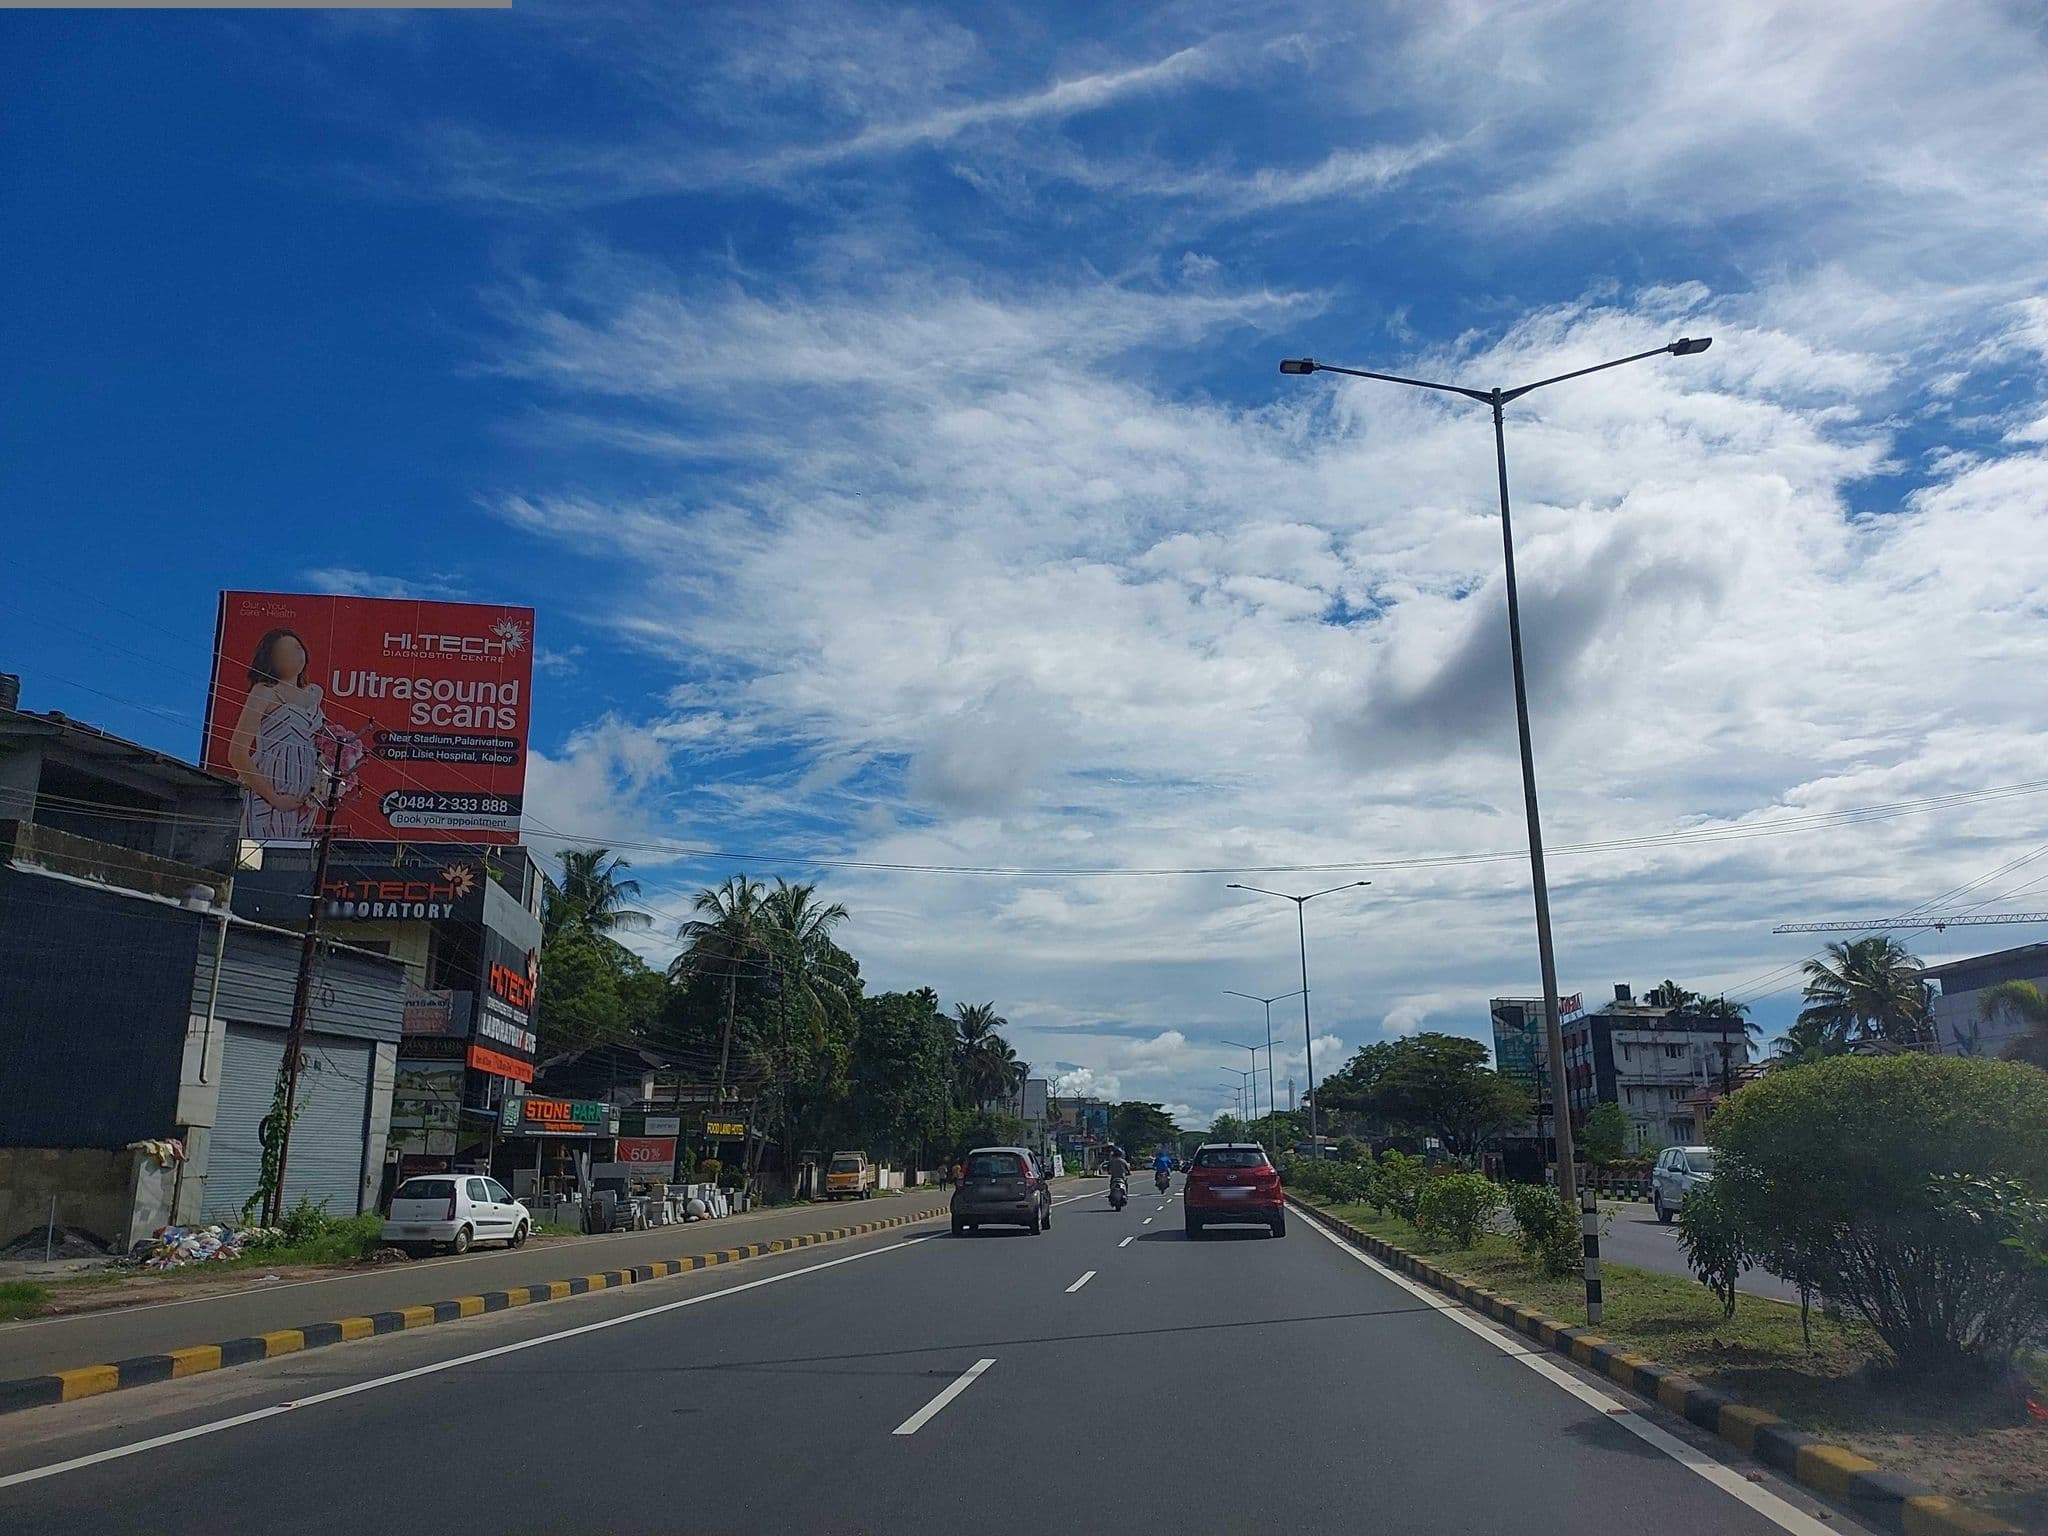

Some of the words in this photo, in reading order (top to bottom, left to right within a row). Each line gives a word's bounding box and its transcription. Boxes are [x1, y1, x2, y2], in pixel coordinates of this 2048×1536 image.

[383, 650, 453, 660] DIAGNOSTIC
[461, 654, 504, 663] CENTRE
[332, 670, 519, 705] Ultrasound
[410, 702, 517, 730] scans
[389, 733, 412, 743] Near
[387, 748, 410, 759] Opp.
[412, 749, 434, 758] Lisie
[436, 750, 478, 762] Hospital,
[481, 753, 513, 763] Kaloor
[398, 796, 435, 810] 0484
[438, 798, 447, 810] 2
[450, 798, 478, 811] 333
[481, 799, 508, 813] 888
[396, 814, 421, 824] Book
[423, 816, 445, 826] your
[447, 817, 507, 828] appointment
[525, 1100, 571, 1120] STONE
[572, 1103, 602, 1121] PARK
